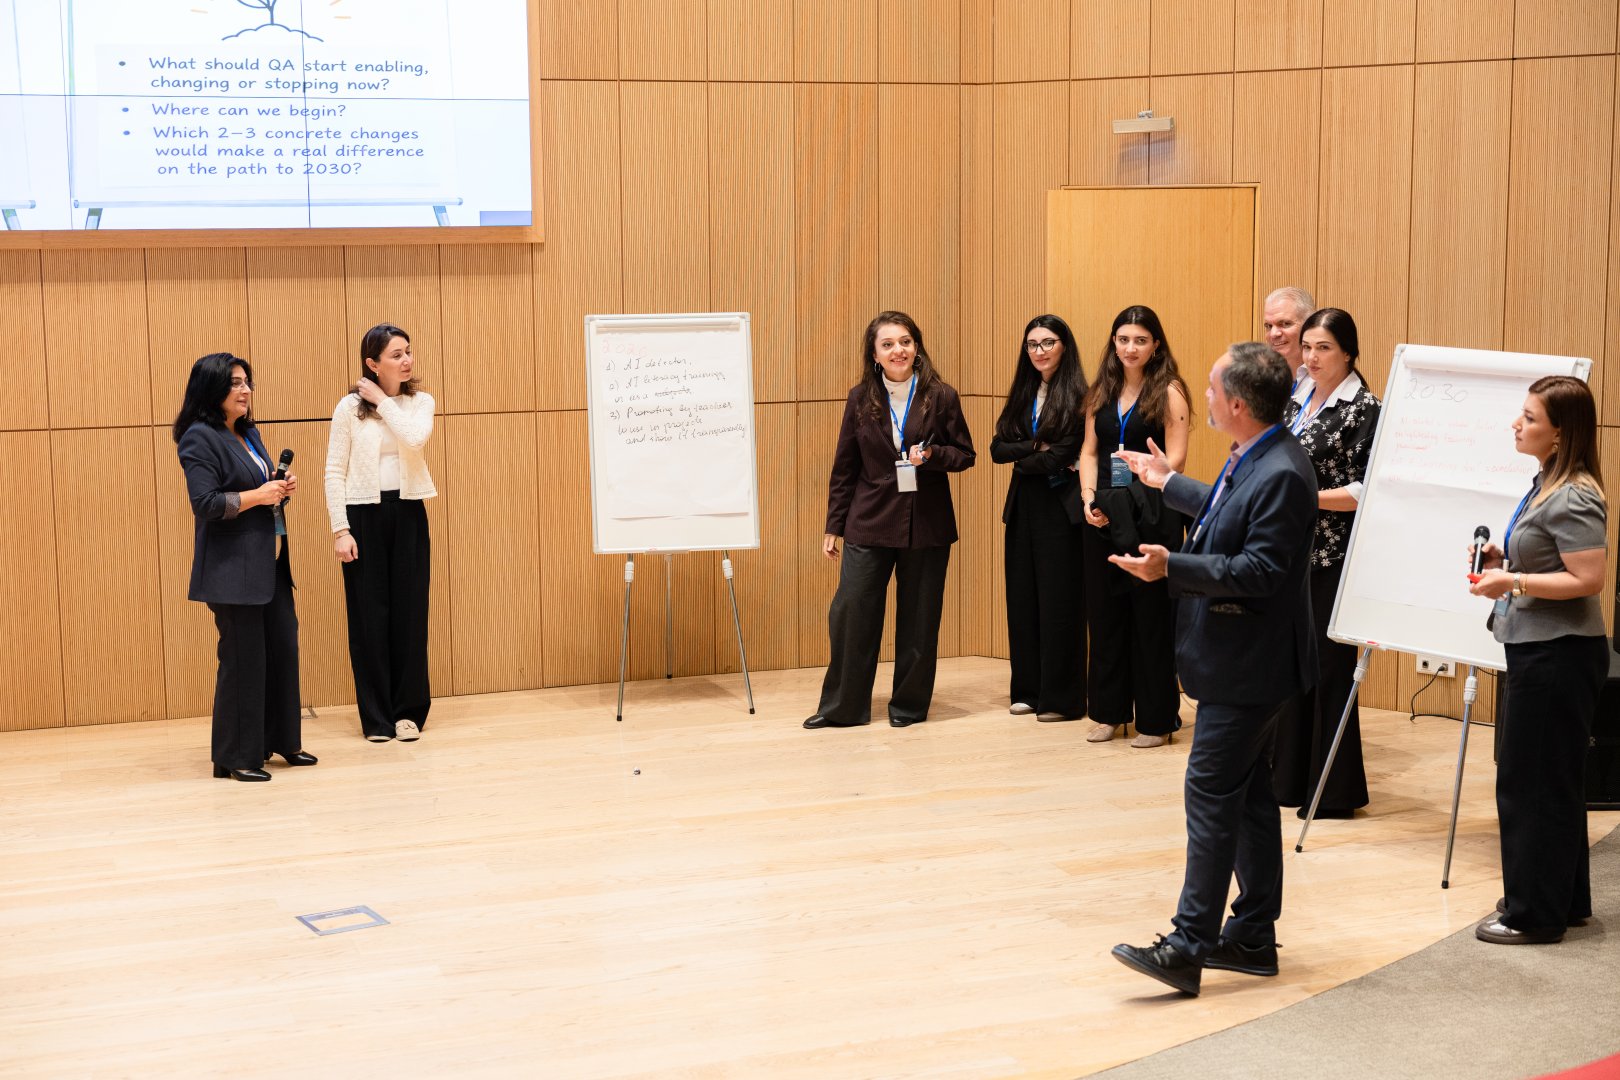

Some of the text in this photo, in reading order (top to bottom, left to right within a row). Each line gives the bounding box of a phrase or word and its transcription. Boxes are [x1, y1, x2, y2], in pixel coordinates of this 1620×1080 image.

[149, 57, 429, 76] What should QA start enabling,
[151, 76, 390, 93] changing or stopping now?
[152, 103, 346, 120] Where can we begin?
[153, 126, 209, 138] Which
[265, 128, 342, 139] concrete
[350, 127, 419, 143] changes
[155, 144, 425, 157] would make a real difference
[157, 162, 362, 179] on the path to 2030?
[606, 360, 616, 372] 1)
[1404, 377, 1469, 403] 2030
[609, 410, 621, 422] 3)
